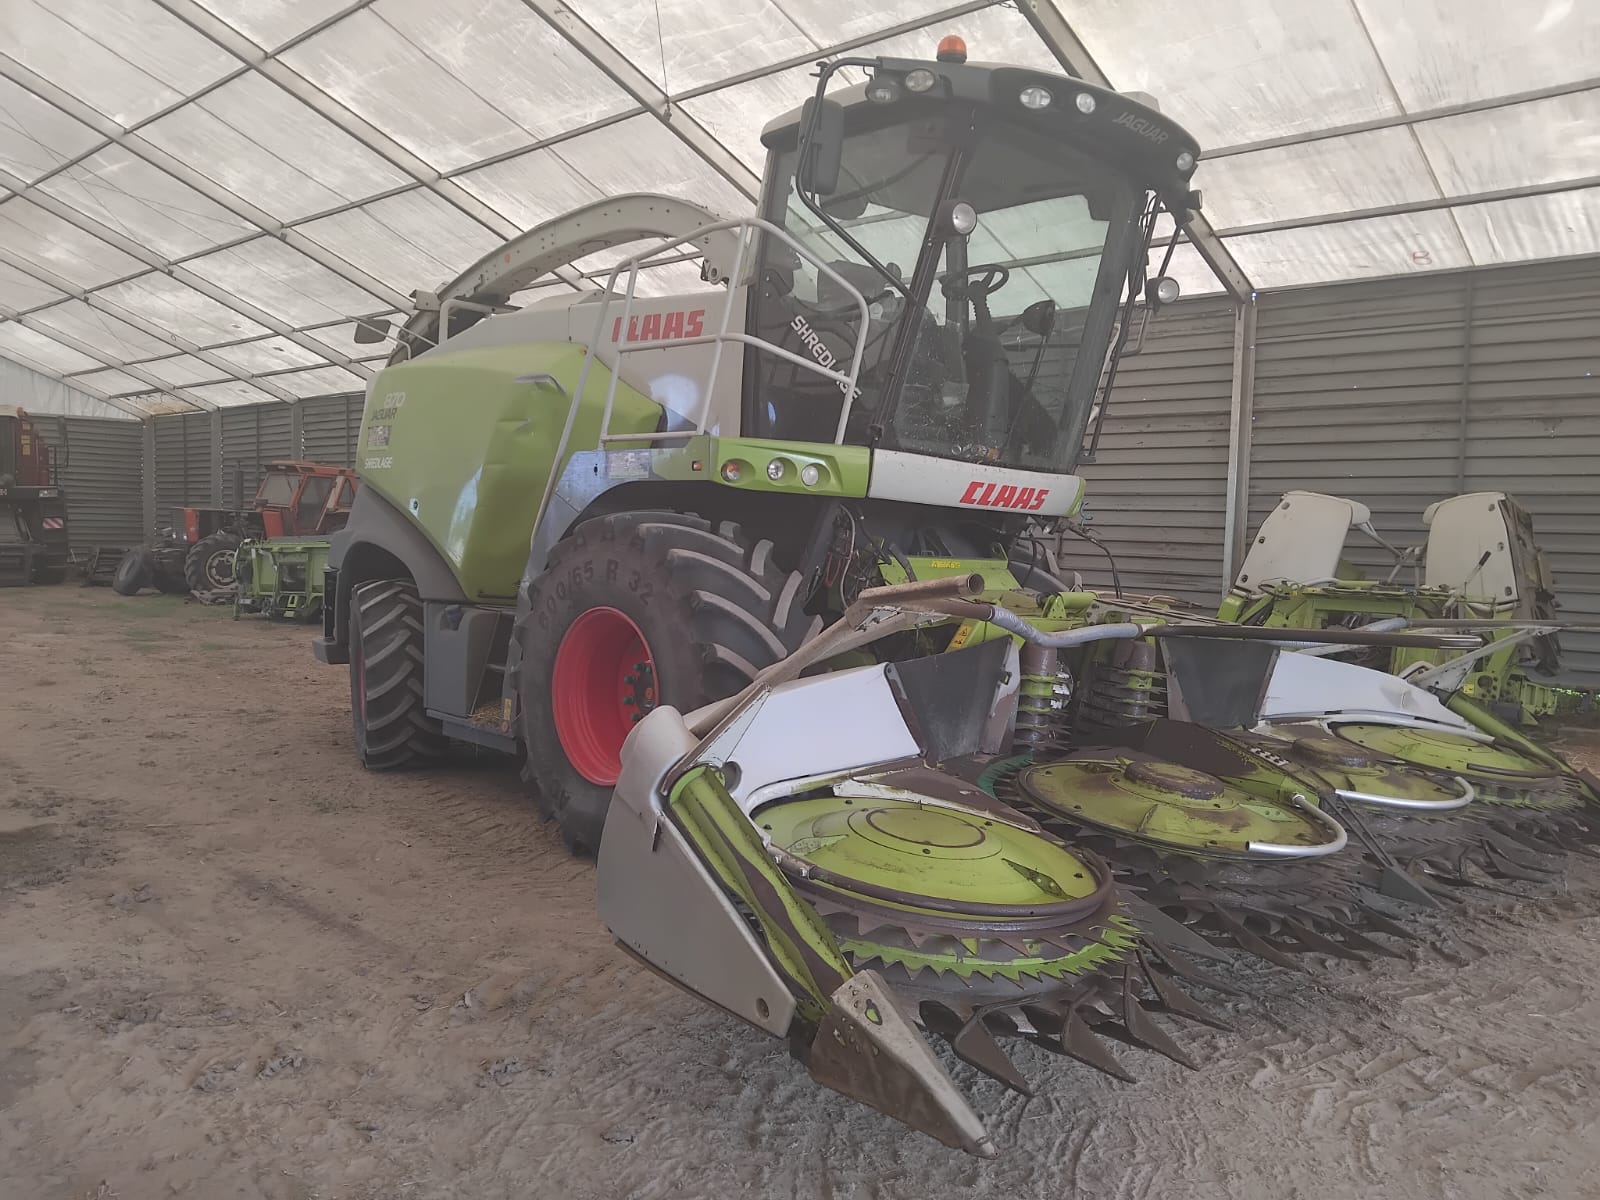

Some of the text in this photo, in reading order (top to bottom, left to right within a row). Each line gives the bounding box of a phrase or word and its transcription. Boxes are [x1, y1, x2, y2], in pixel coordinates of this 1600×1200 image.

[1112, 112, 1169, 144] JAGUAR
[611, 309, 705, 343] CLAAS
[959, 481, 1050, 511] CLAAS
[606, 558, 618, 581] R
